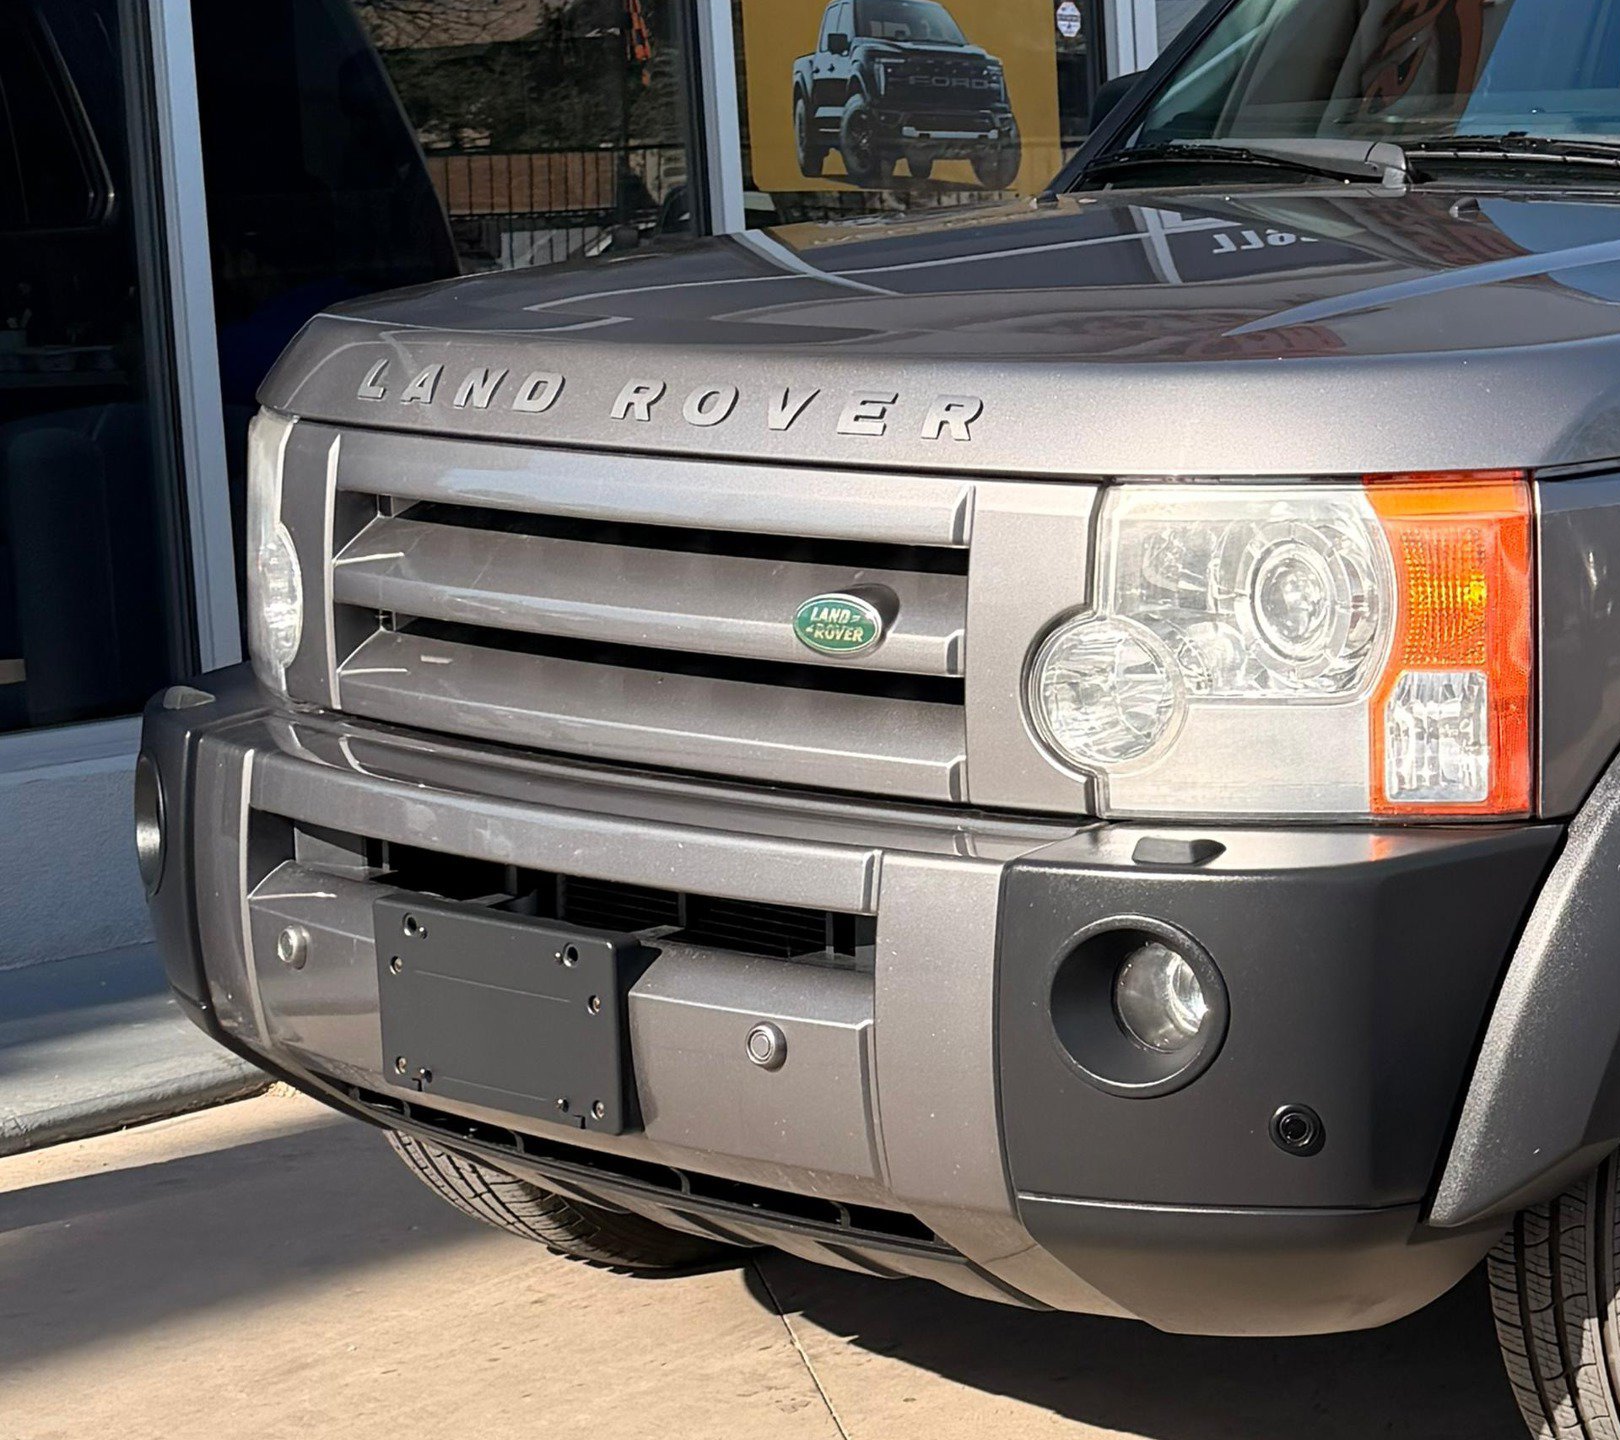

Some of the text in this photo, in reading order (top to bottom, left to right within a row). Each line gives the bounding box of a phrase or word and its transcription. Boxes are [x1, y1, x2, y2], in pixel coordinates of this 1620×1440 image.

[909, 75, 989, 89] FORD
[356, 358, 986, 442] LAND ROVER
[810, 606, 851, 624] LAND
[813, 624, 864, 643] ROVER
